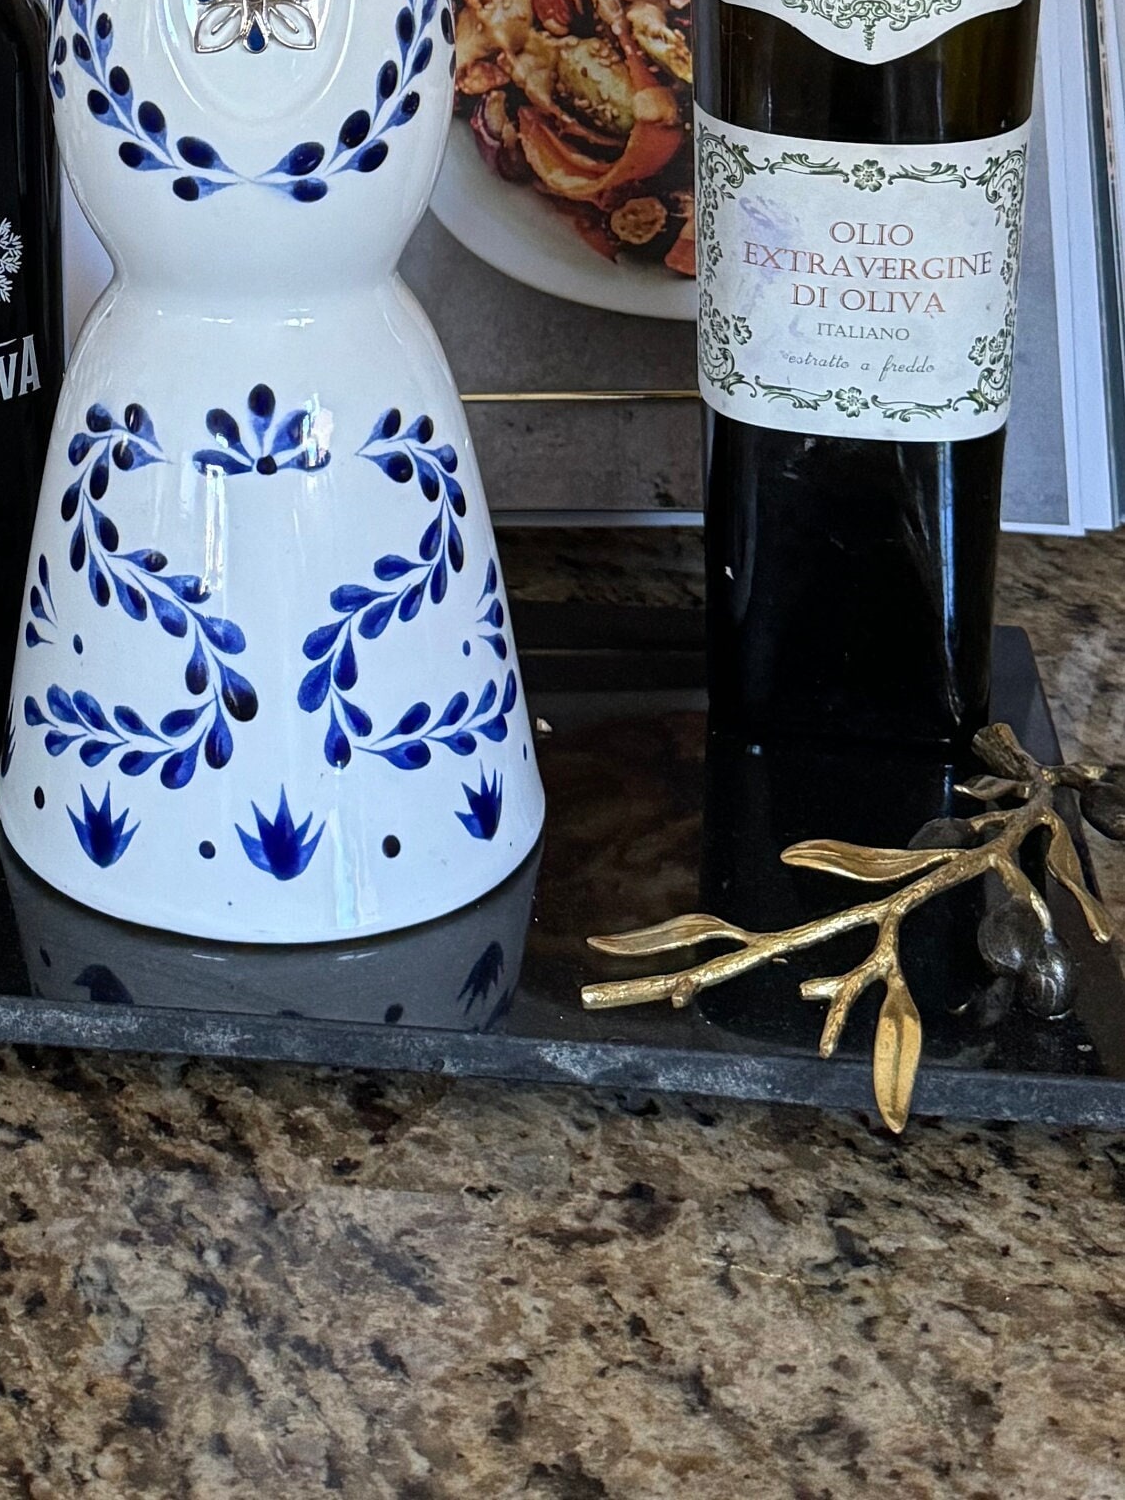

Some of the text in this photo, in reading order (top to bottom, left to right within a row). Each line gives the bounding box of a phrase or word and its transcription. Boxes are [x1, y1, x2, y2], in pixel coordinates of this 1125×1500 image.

[829, 221, 914, 247] OLIO
[790, 283, 946, 314] DI OLIVA
[817, 322, 910, 341] ITALIANO
[788, 351, 935, 382] estratto a freddo
